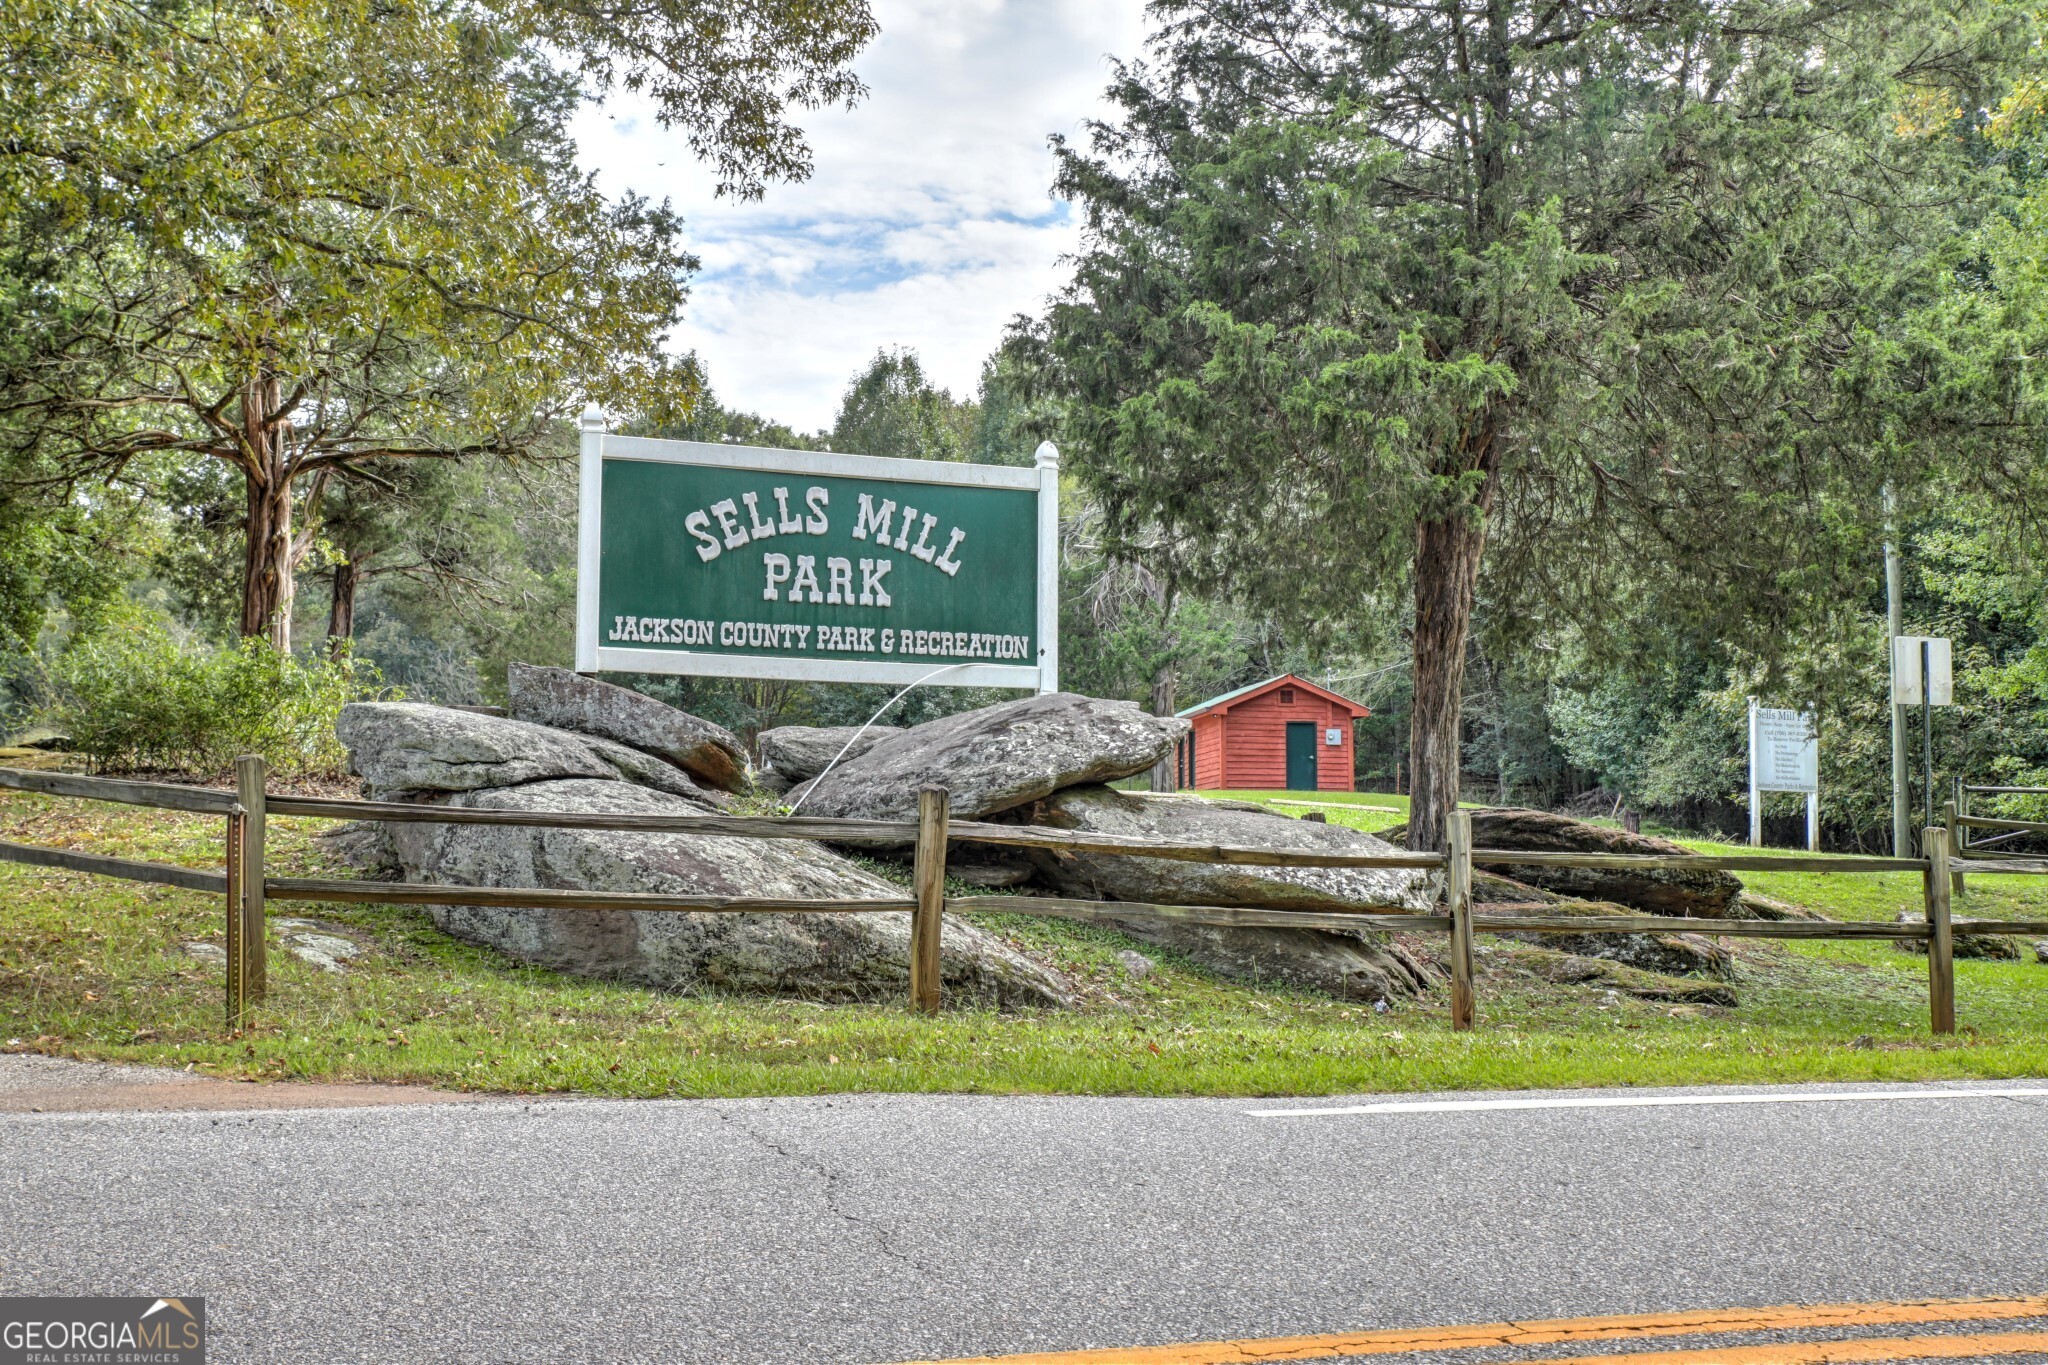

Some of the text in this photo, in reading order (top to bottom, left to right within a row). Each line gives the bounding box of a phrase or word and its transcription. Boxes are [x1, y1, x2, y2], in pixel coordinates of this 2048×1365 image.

[684, 486, 967, 577] SELLS MILL
[762, 552, 893, 608] PARK
[608, 615, 1030, 660] JACKSON COUNTY PARK & RECREATION
[1755, 709, 1776, 719] Sells
[1778, 710, 1794, 720] Mill
